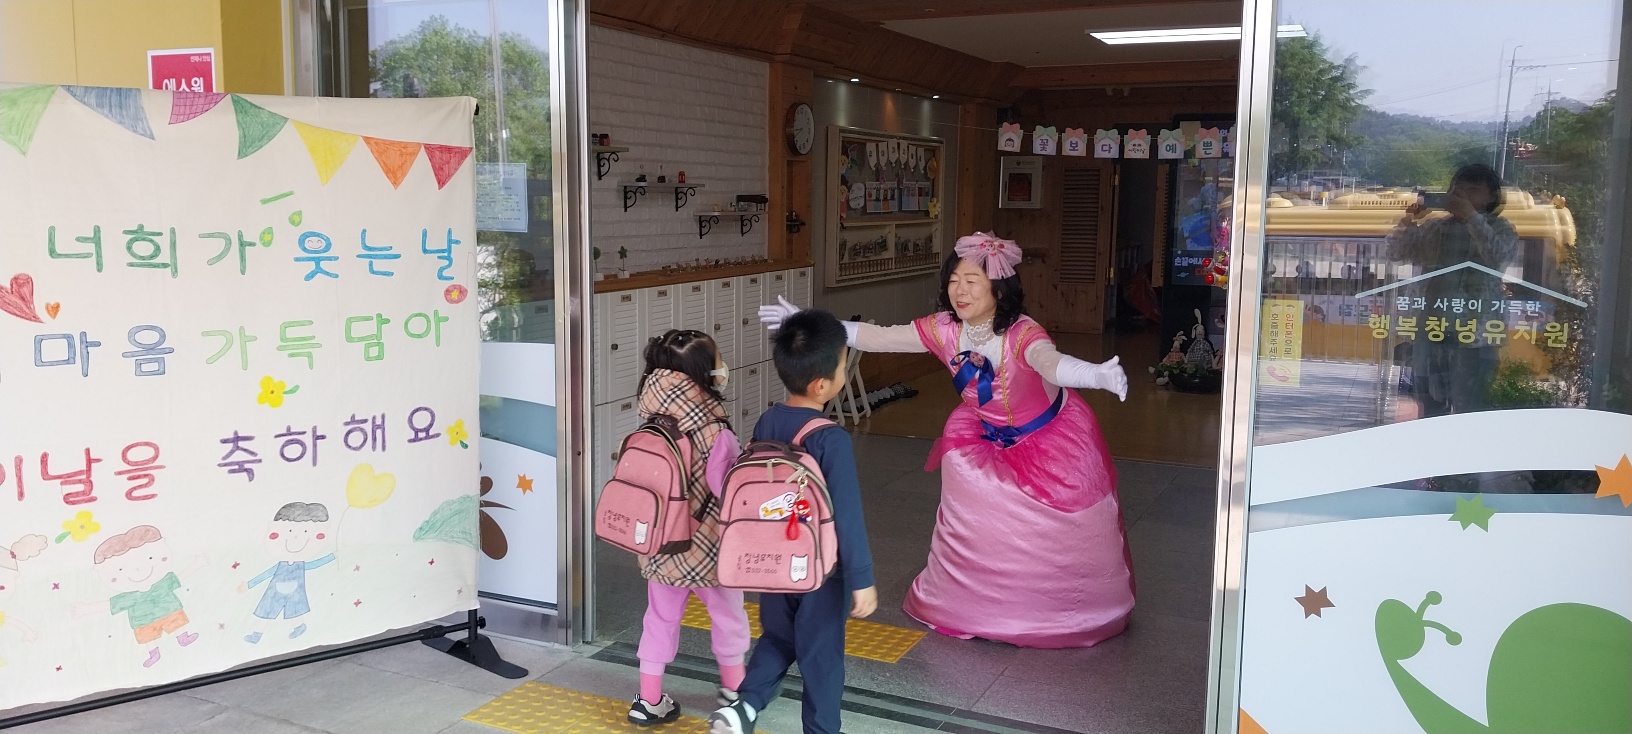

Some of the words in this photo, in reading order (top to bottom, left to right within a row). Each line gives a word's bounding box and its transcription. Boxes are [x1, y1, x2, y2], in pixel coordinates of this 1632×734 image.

[47, 224, 257, 279] 너희가
[293, 227, 402, 281] 웃는
[421, 227, 461, 281] 날
[1367, 314, 1569, 348] 행복창녕유치원
[1396, 296, 1427, 311] 꿈과
[1433, 298, 1483, 313] 사랑이
[1490, 300, 1542, 317] 가득한
[34, 324, 175, 377] 마음
[201, 319, 323, 371] 가득
[344, 309, 449, 362] 담아
[217, 406, 442, 482] 축하해요
